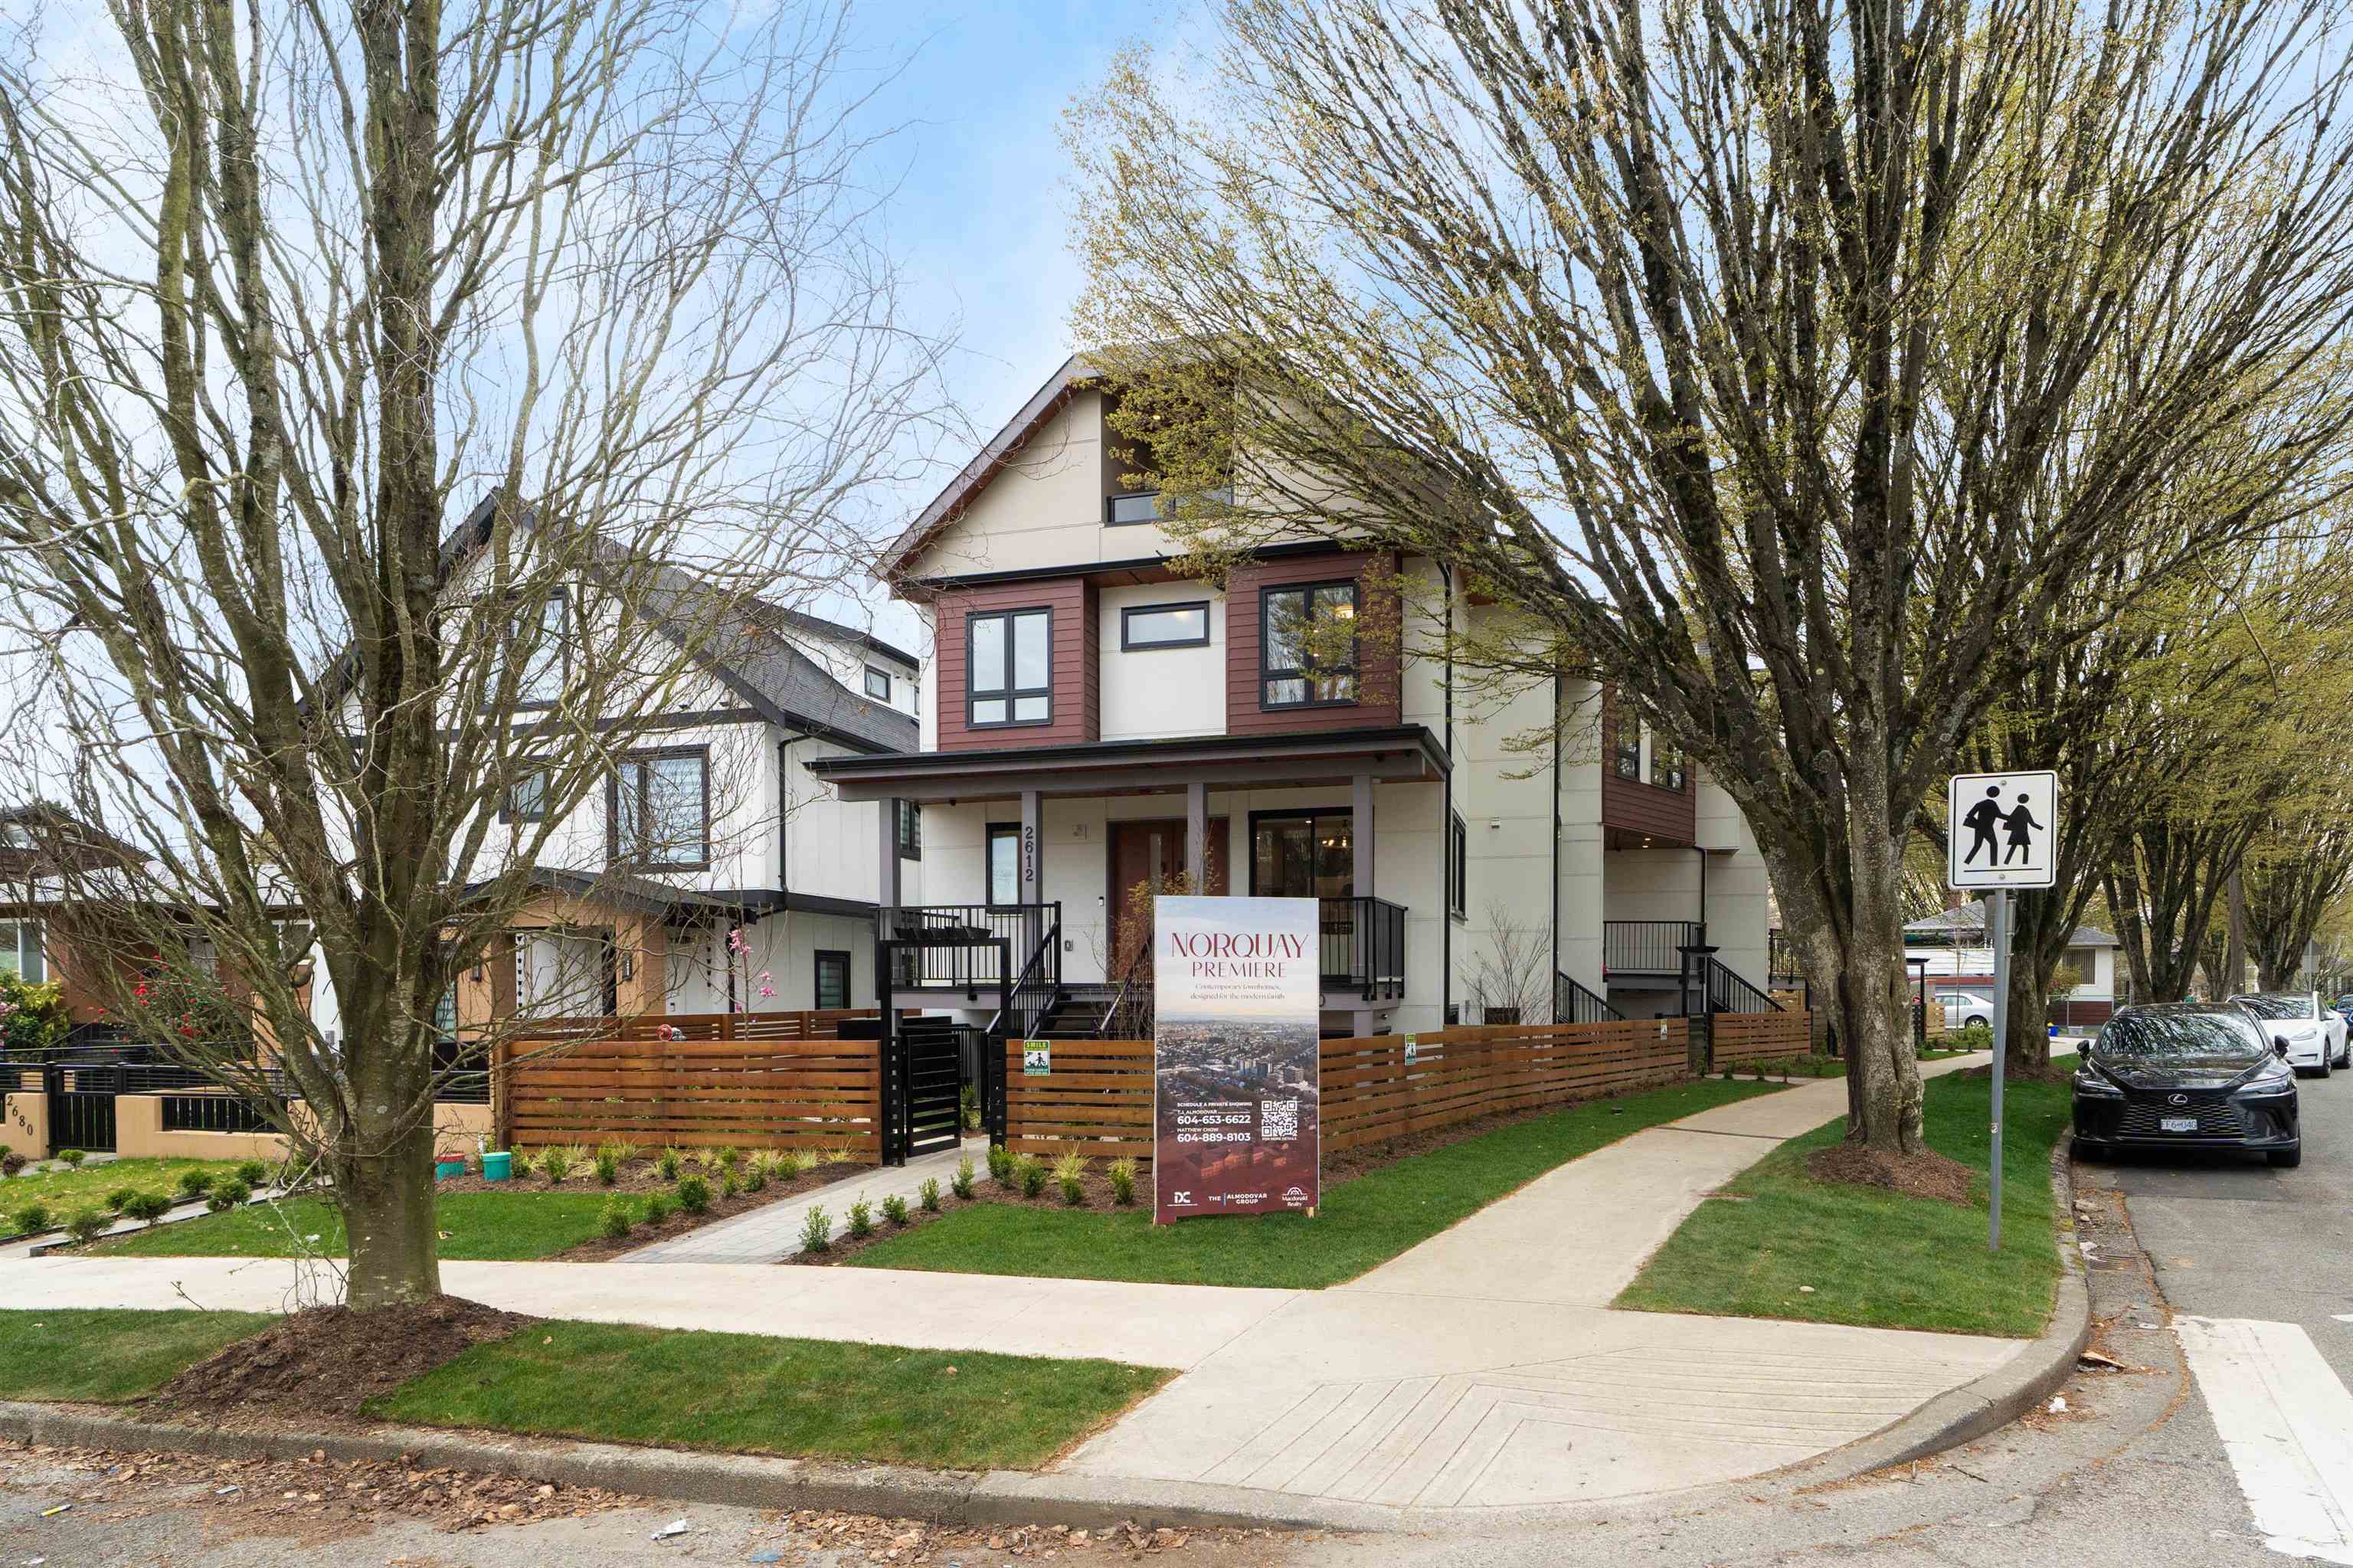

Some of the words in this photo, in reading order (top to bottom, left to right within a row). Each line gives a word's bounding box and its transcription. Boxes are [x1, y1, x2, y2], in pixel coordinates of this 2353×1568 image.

[1025, 827, 1034, 882] 2612
[1171, 932, 1309, 958] NORQUAY
[1192, 961, 1288, 978] PREMIERE
[6, 1095, 34, 1136] 2680
[1176, 1115, 1251, 1124] 604-653-6622
[1176, 1133, 1251, 1142] 604-889-8103
